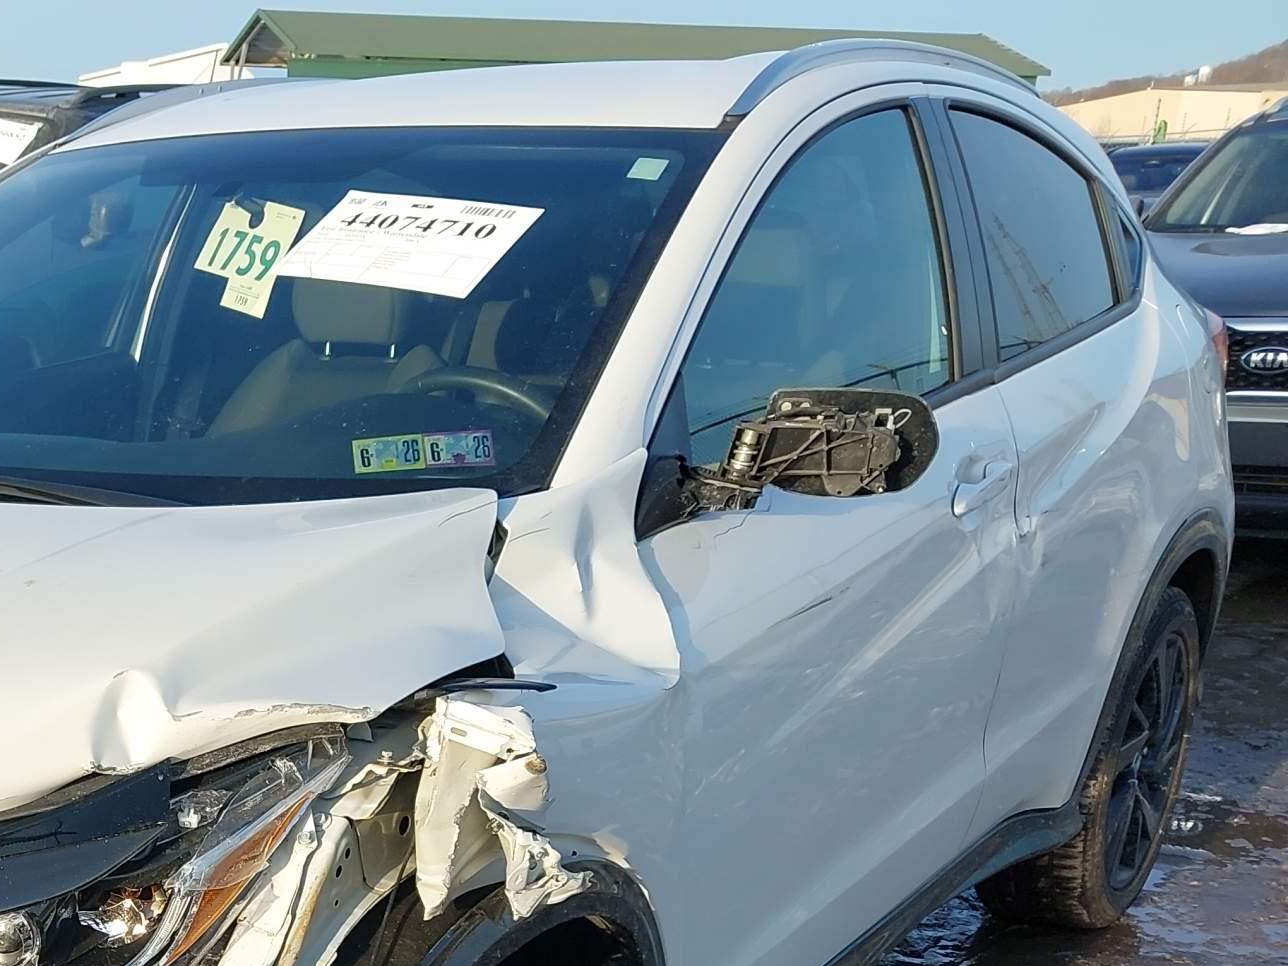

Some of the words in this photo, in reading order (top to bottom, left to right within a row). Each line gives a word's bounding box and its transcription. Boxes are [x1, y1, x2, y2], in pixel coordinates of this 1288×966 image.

[341, 212, 497, 239] 44074710
[207, 227, 281, 281] 1759
[233, 295, 249, 306] 1759
[1249, 352, 1288, 368] KIA
[402, 439, 421, 463] 26
[473, 435, 491, 459] 26
